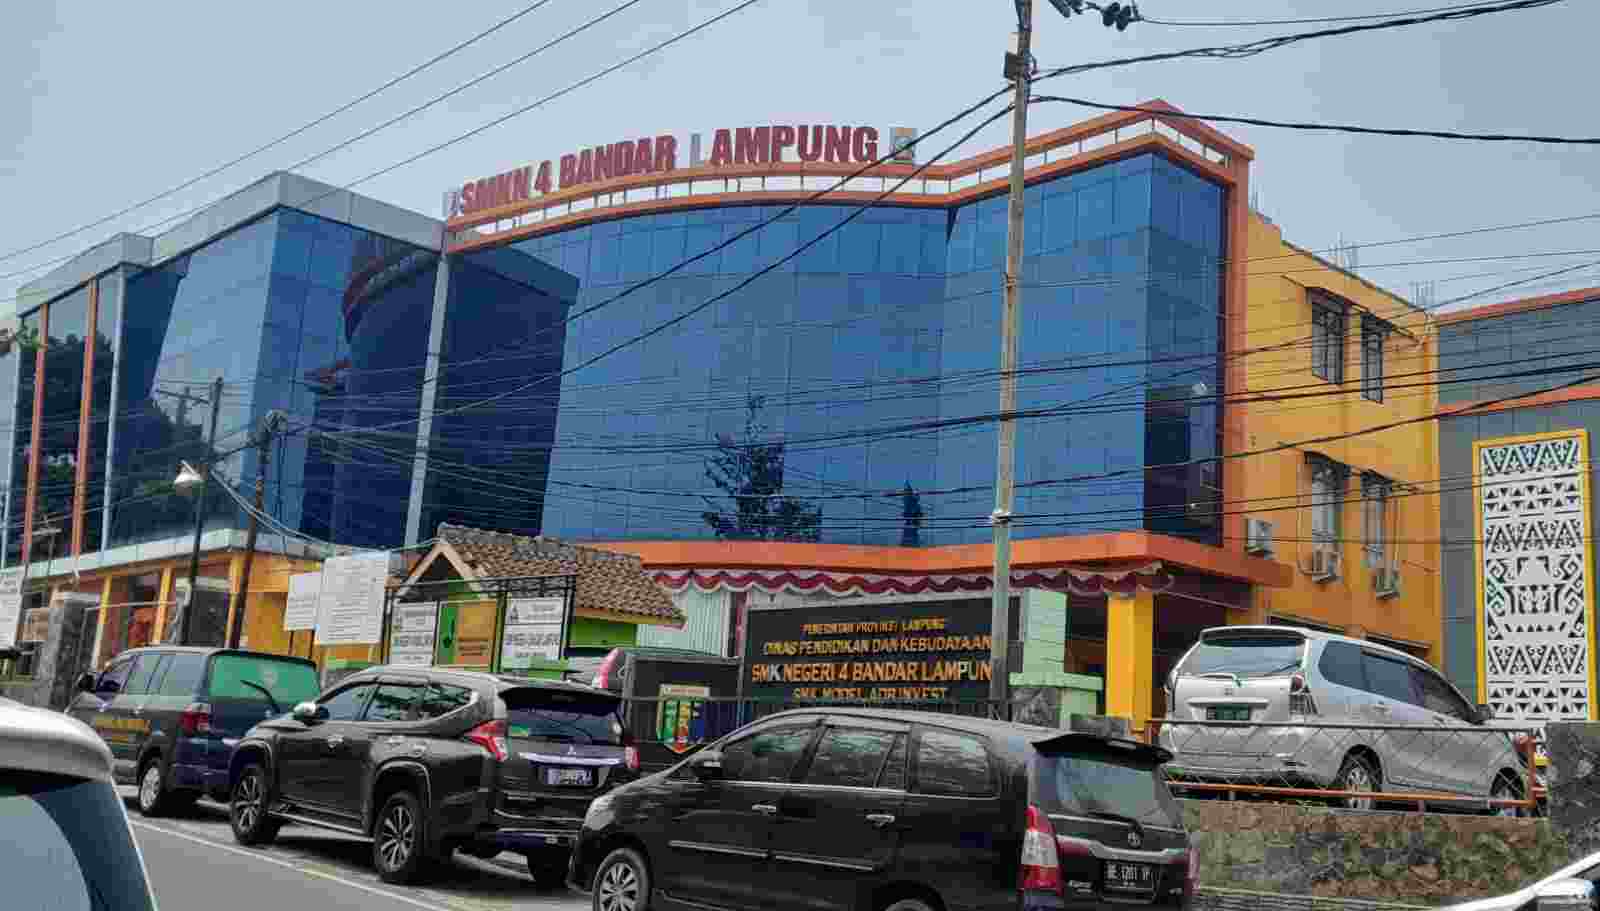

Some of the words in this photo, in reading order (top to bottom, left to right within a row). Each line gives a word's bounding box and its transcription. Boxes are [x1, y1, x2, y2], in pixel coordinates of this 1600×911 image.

[462, 166, 532, 216] SMKN
[533, 159, 553, 194] 4
[559, 135, 678, 187] BANDAR
[690, 125, 880, 166] LAMPUNG
[762, 640, 797, 656] DINAS
[799, 639, 872, 656] PENDIDIKAN
[876, 638, 899, 653] DAN
[900, 635, 992, 651] KEBUDAYAAN
[751, 663, 781, 682] SMK
[783, 662, 836, 682] NEGERI
[838, 662, 850, 681] 4
[852, 661, 918, 681] BANDAR
[922, 659, 992, 681] LAMPUN
